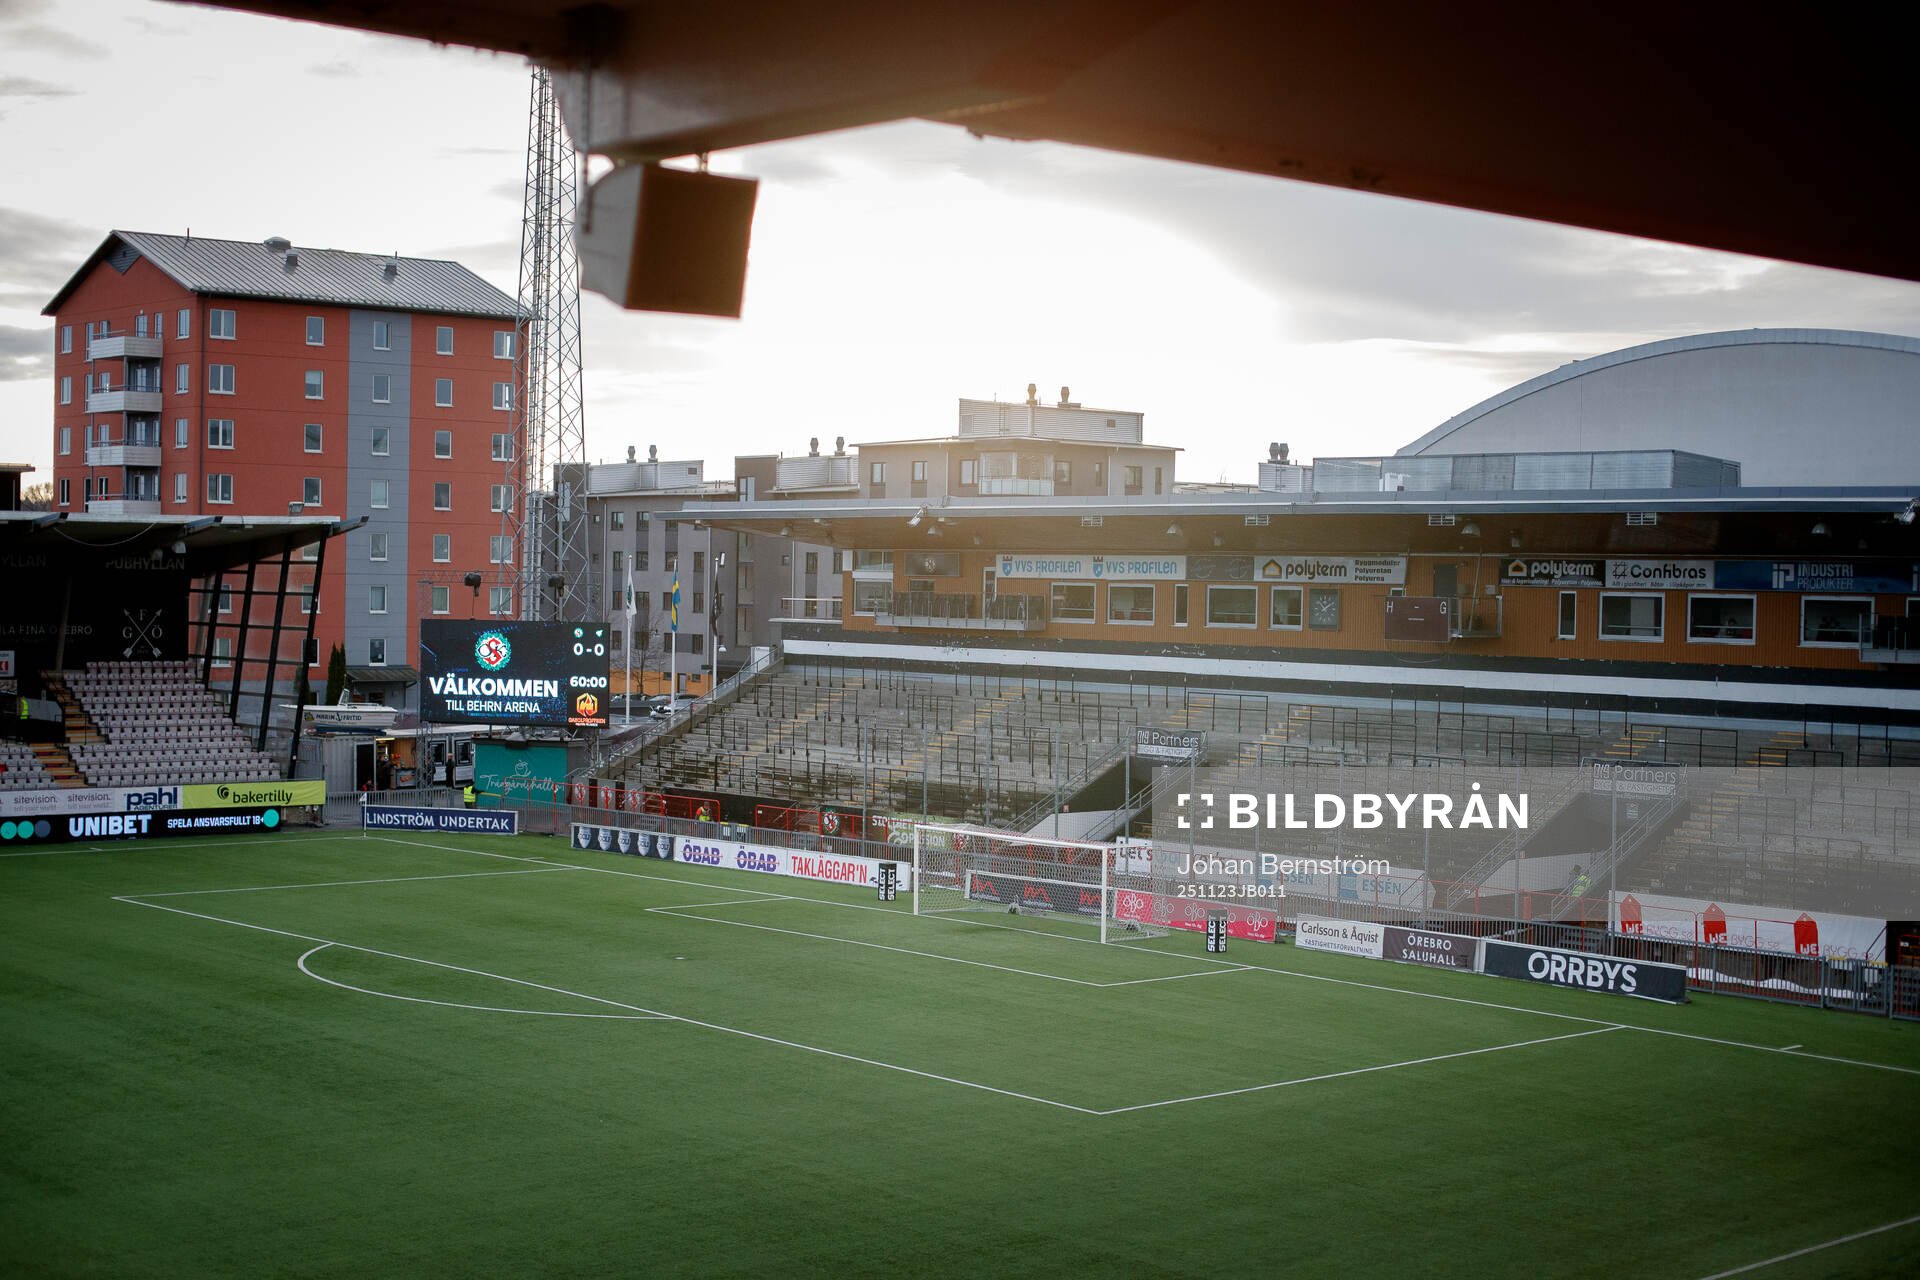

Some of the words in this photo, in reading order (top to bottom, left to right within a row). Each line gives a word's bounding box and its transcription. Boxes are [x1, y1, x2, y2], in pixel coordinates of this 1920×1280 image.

[1014, 560, 1033, 573] VVS
[1105, 561, 1126, 575] VVS
[1285, 560, 1348, 580] polyterm
[1530, 559, 1594, 578] polyterm
[1797, 563, 1854, 577] INDUSTRI
[1797, 577, 1855, 590] PRODUKTER
[1386, 601, 1394, 614] H
[1439, 601, 1447, 615] G
[573, 643, 584, 657] 0
[594, 643, 605, 657] 0
[428, 672, 559, 699] VÄLKOMMEN
[569, 675, 608, 689] 60:00
[445, 699, 465, 712] TILL
[467, 700, 503, 713] BEHRN
[504, 701, 541, 714] ARENA
[1152, 732, 1200, 748] Partners
[1614, 765, 1677, 784] Partners
[126, 787, 178, 811] pahl
[232, 789, 294, 806] bakertilly
[69, 814, 152, 838] UNIBET
[167, 818, 193, 829] SPELA
[194, 815, 252, 828] ANSVARSFULLT
[366, 812, 435, 827] LINDSTRÖM
[439, 815, 510, 831] UNDERTAK
[682, 839, 721, 865] ÖBAB
[736, 845, 778, 872] ÖBAB
[791, 854, 868, 884] TAKLÄGGAR'N
[878, 868, 886, 901] SELECT
[887, 868, 896, 901] SELECT
[1362, 878, 1401, 895] ESSÉN
[1208, 915, 1216, 952] SELECT
[1218, 915, 1227, 952] SELECT
[1301, 922, 1340, 938] Carlsson
[1341, 929, 1348, 938] &
[1350, 926, 1379, 944] Åqvist
[1407, 932, 1452, 951] ÖREBRO
[1402, 948, 1456, 966] SALUHALL
[1799, 943, 1817, 954] WE
[1527, 951, 1638, 993] ORRBYS
